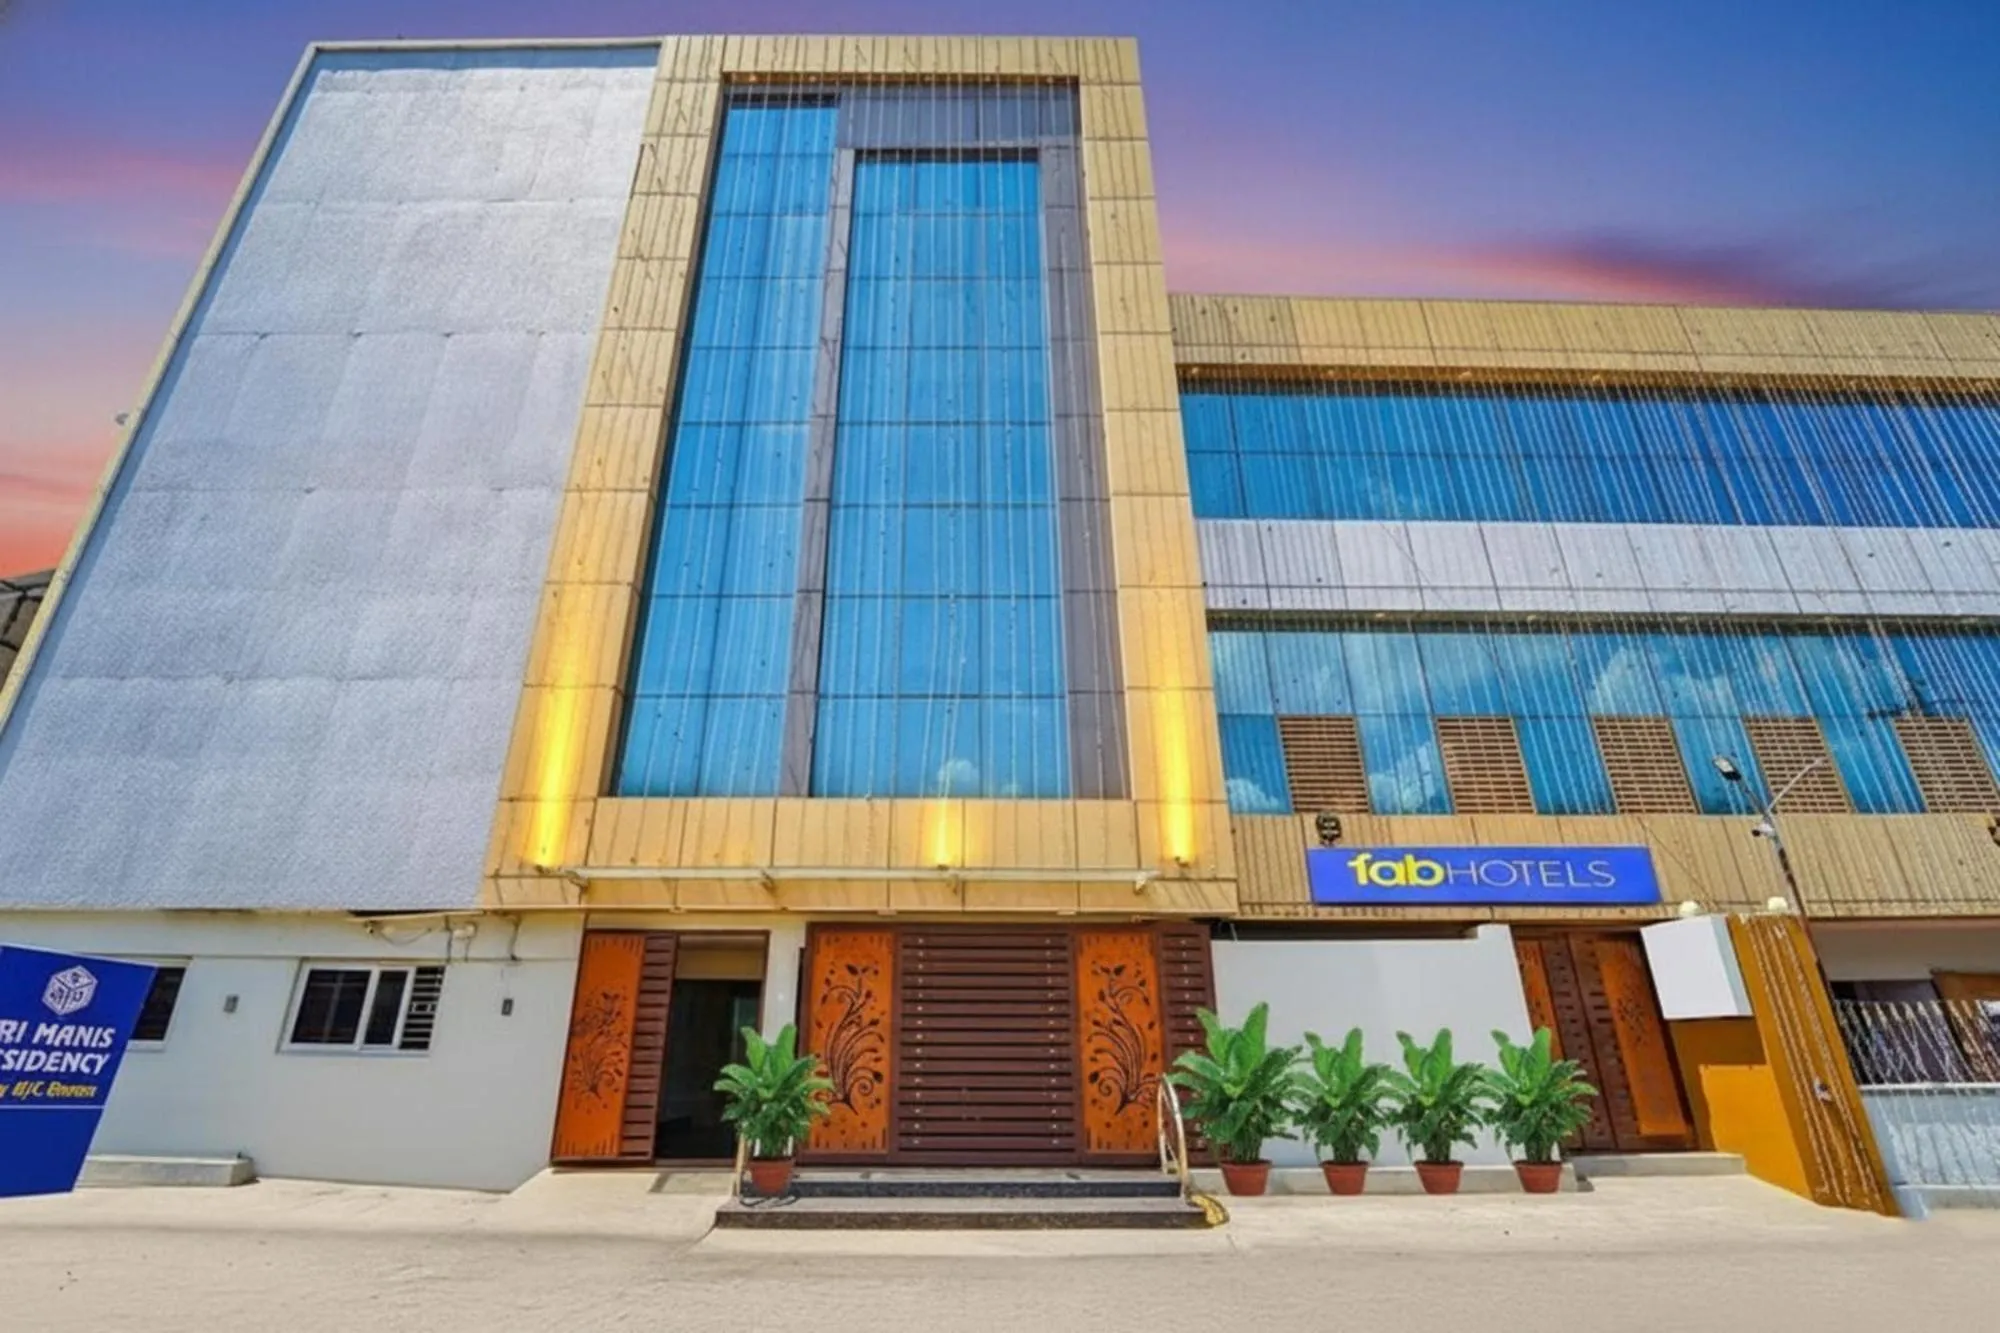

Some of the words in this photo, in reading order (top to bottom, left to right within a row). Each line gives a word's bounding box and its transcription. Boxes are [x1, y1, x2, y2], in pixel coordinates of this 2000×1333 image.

[1347, 853, 1616, 887] fabHOTELS
[32, 1022, 116, 1048] MANIS
[0, 1048, 111, 1075] SIDENCY
